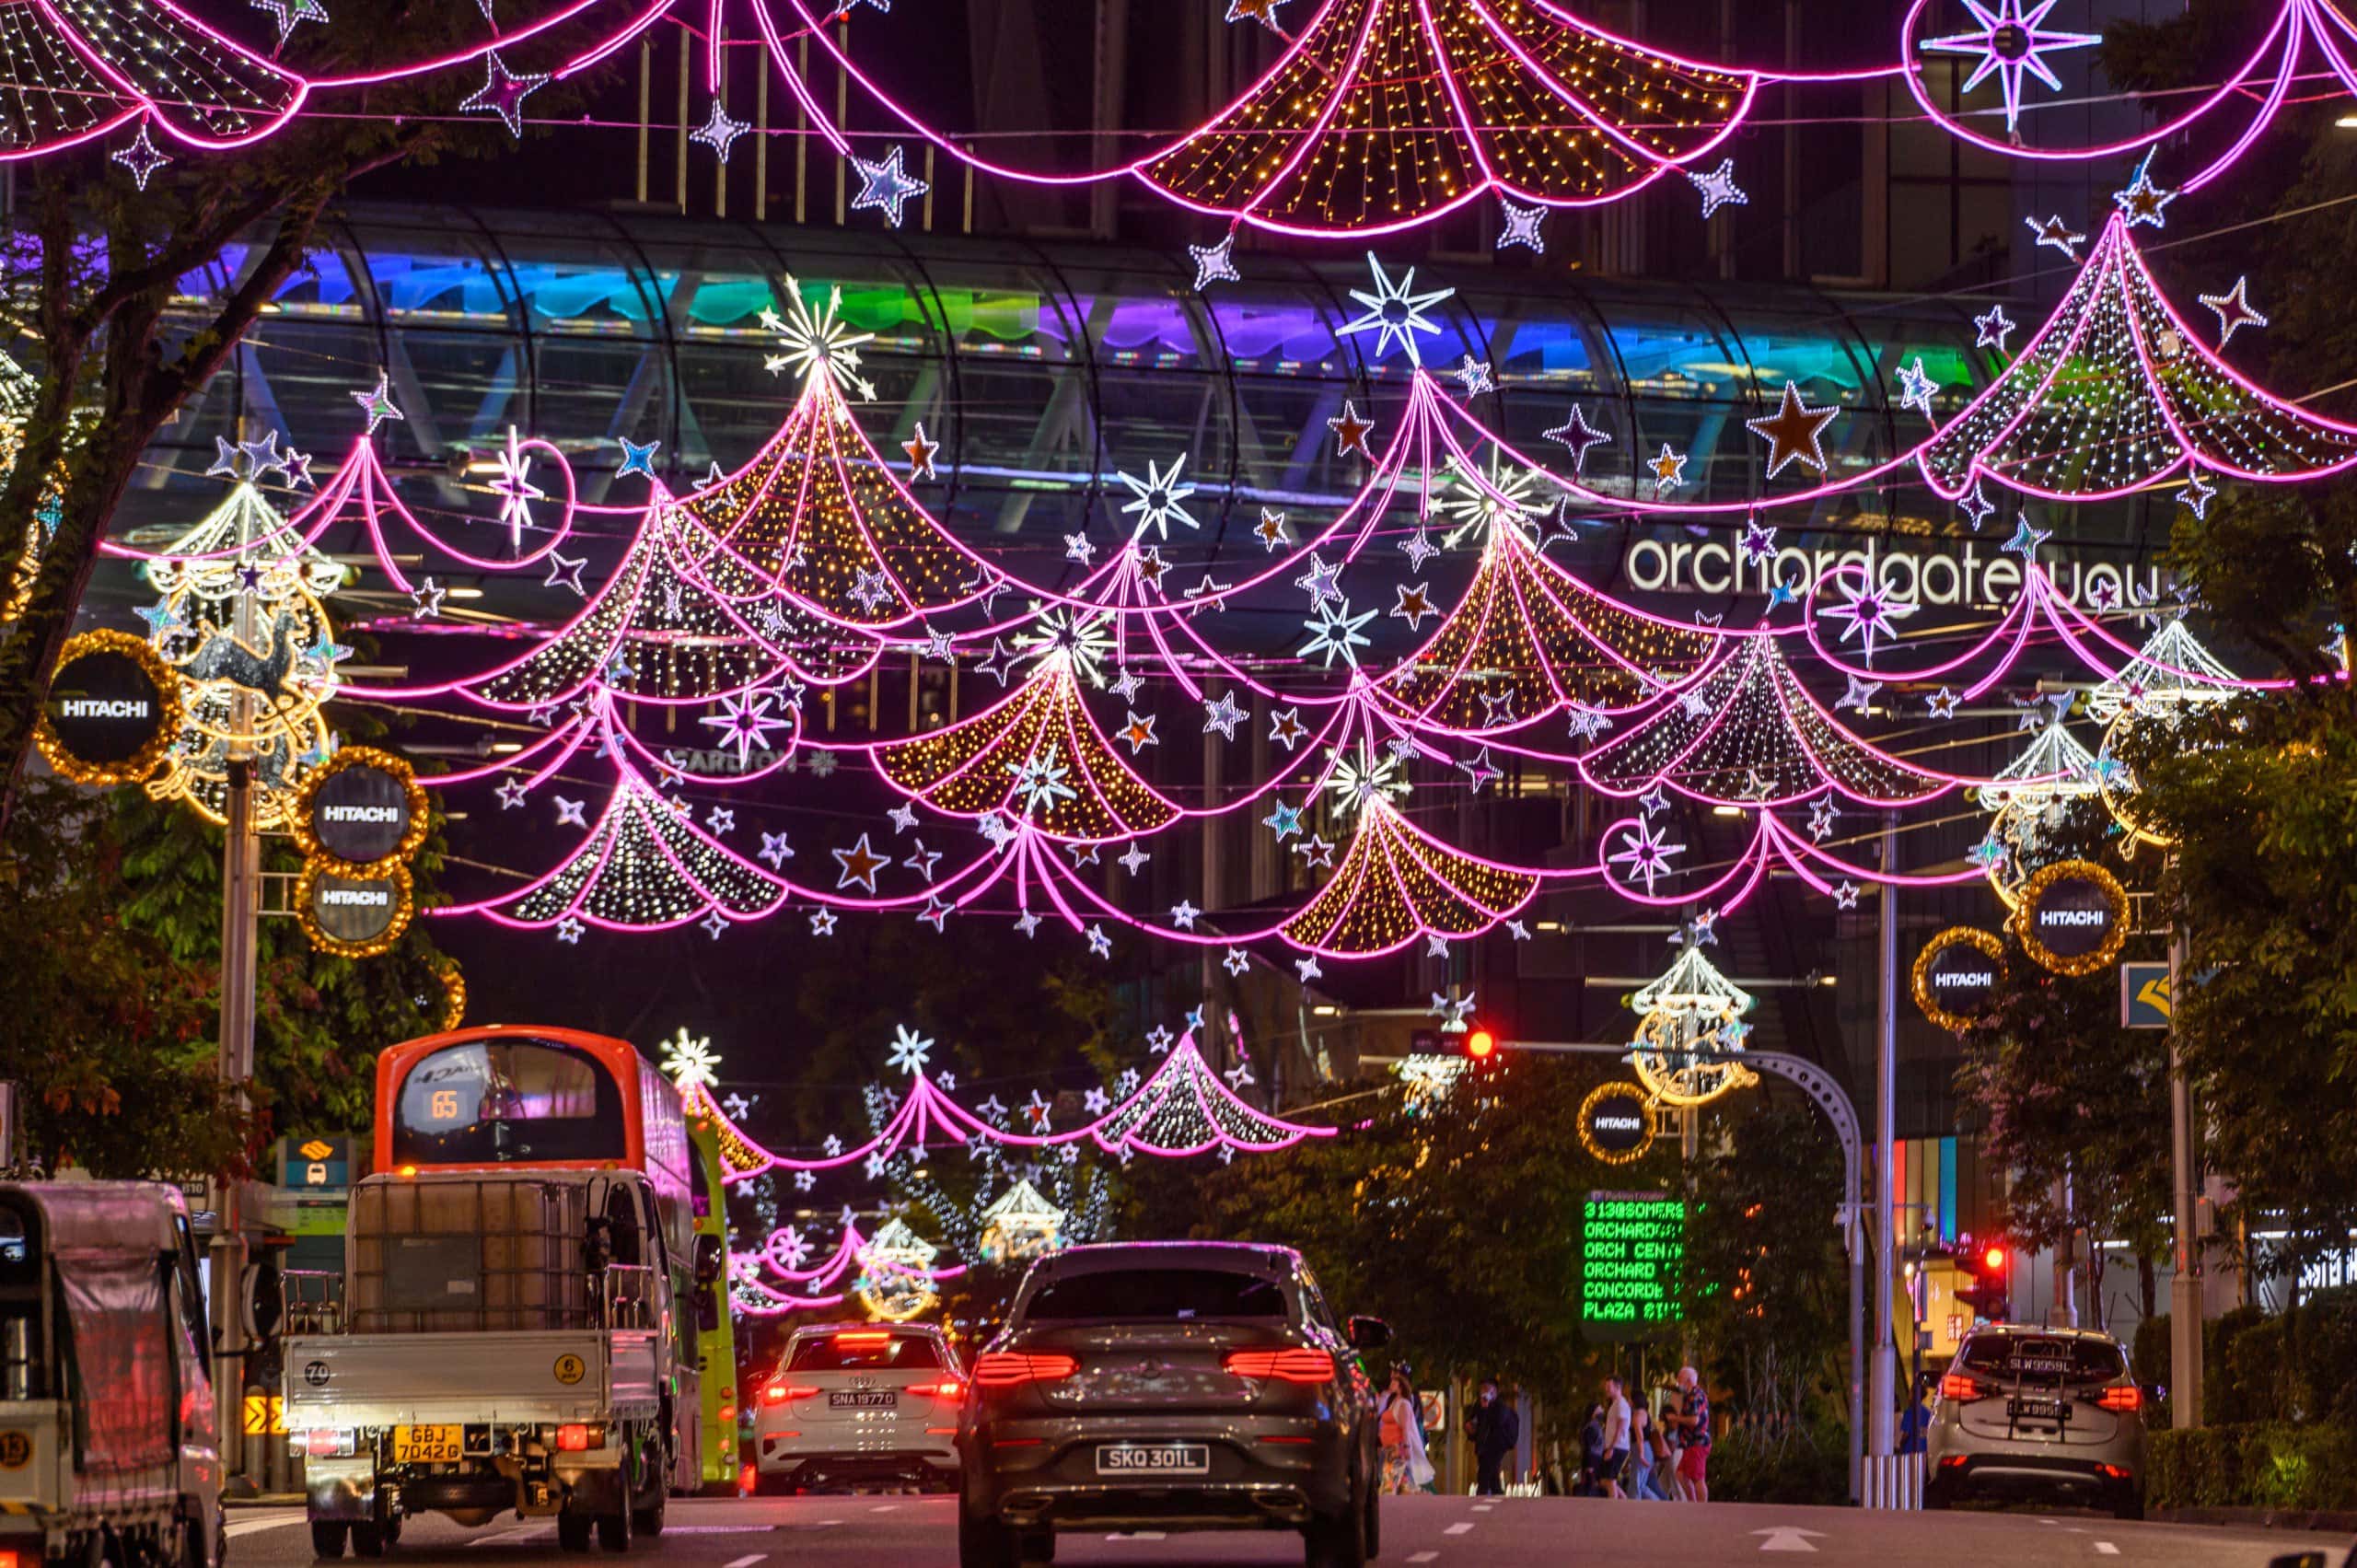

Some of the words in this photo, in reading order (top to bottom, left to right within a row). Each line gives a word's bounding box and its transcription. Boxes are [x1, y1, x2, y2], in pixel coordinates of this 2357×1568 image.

[63, 700, 148, 717] HITACHI
[324, 806, 399, 822] HITACHI
[322, 890, 388, 906] HITACHI
[2040, 911, 2104, 926] HITACHI
[1935, 972, 1992, 987] HITACHI
[432, 1090, 458, 1119] 65
[1595, 1117, 1640, 1131] HITACHI
[1584, 1242, 1626, 1259] ORCH
[1584, 1261, 1655, 1279] ORCHARD
[1583, 1301, 1635, 1318] PLAZA
[307, 1365, 329, 1379] 70
[563, 1359, 575, 1372] 6
[411, 1428, 446, 1443] GBJ
[399, 1445, 459, 1459] 7042G
